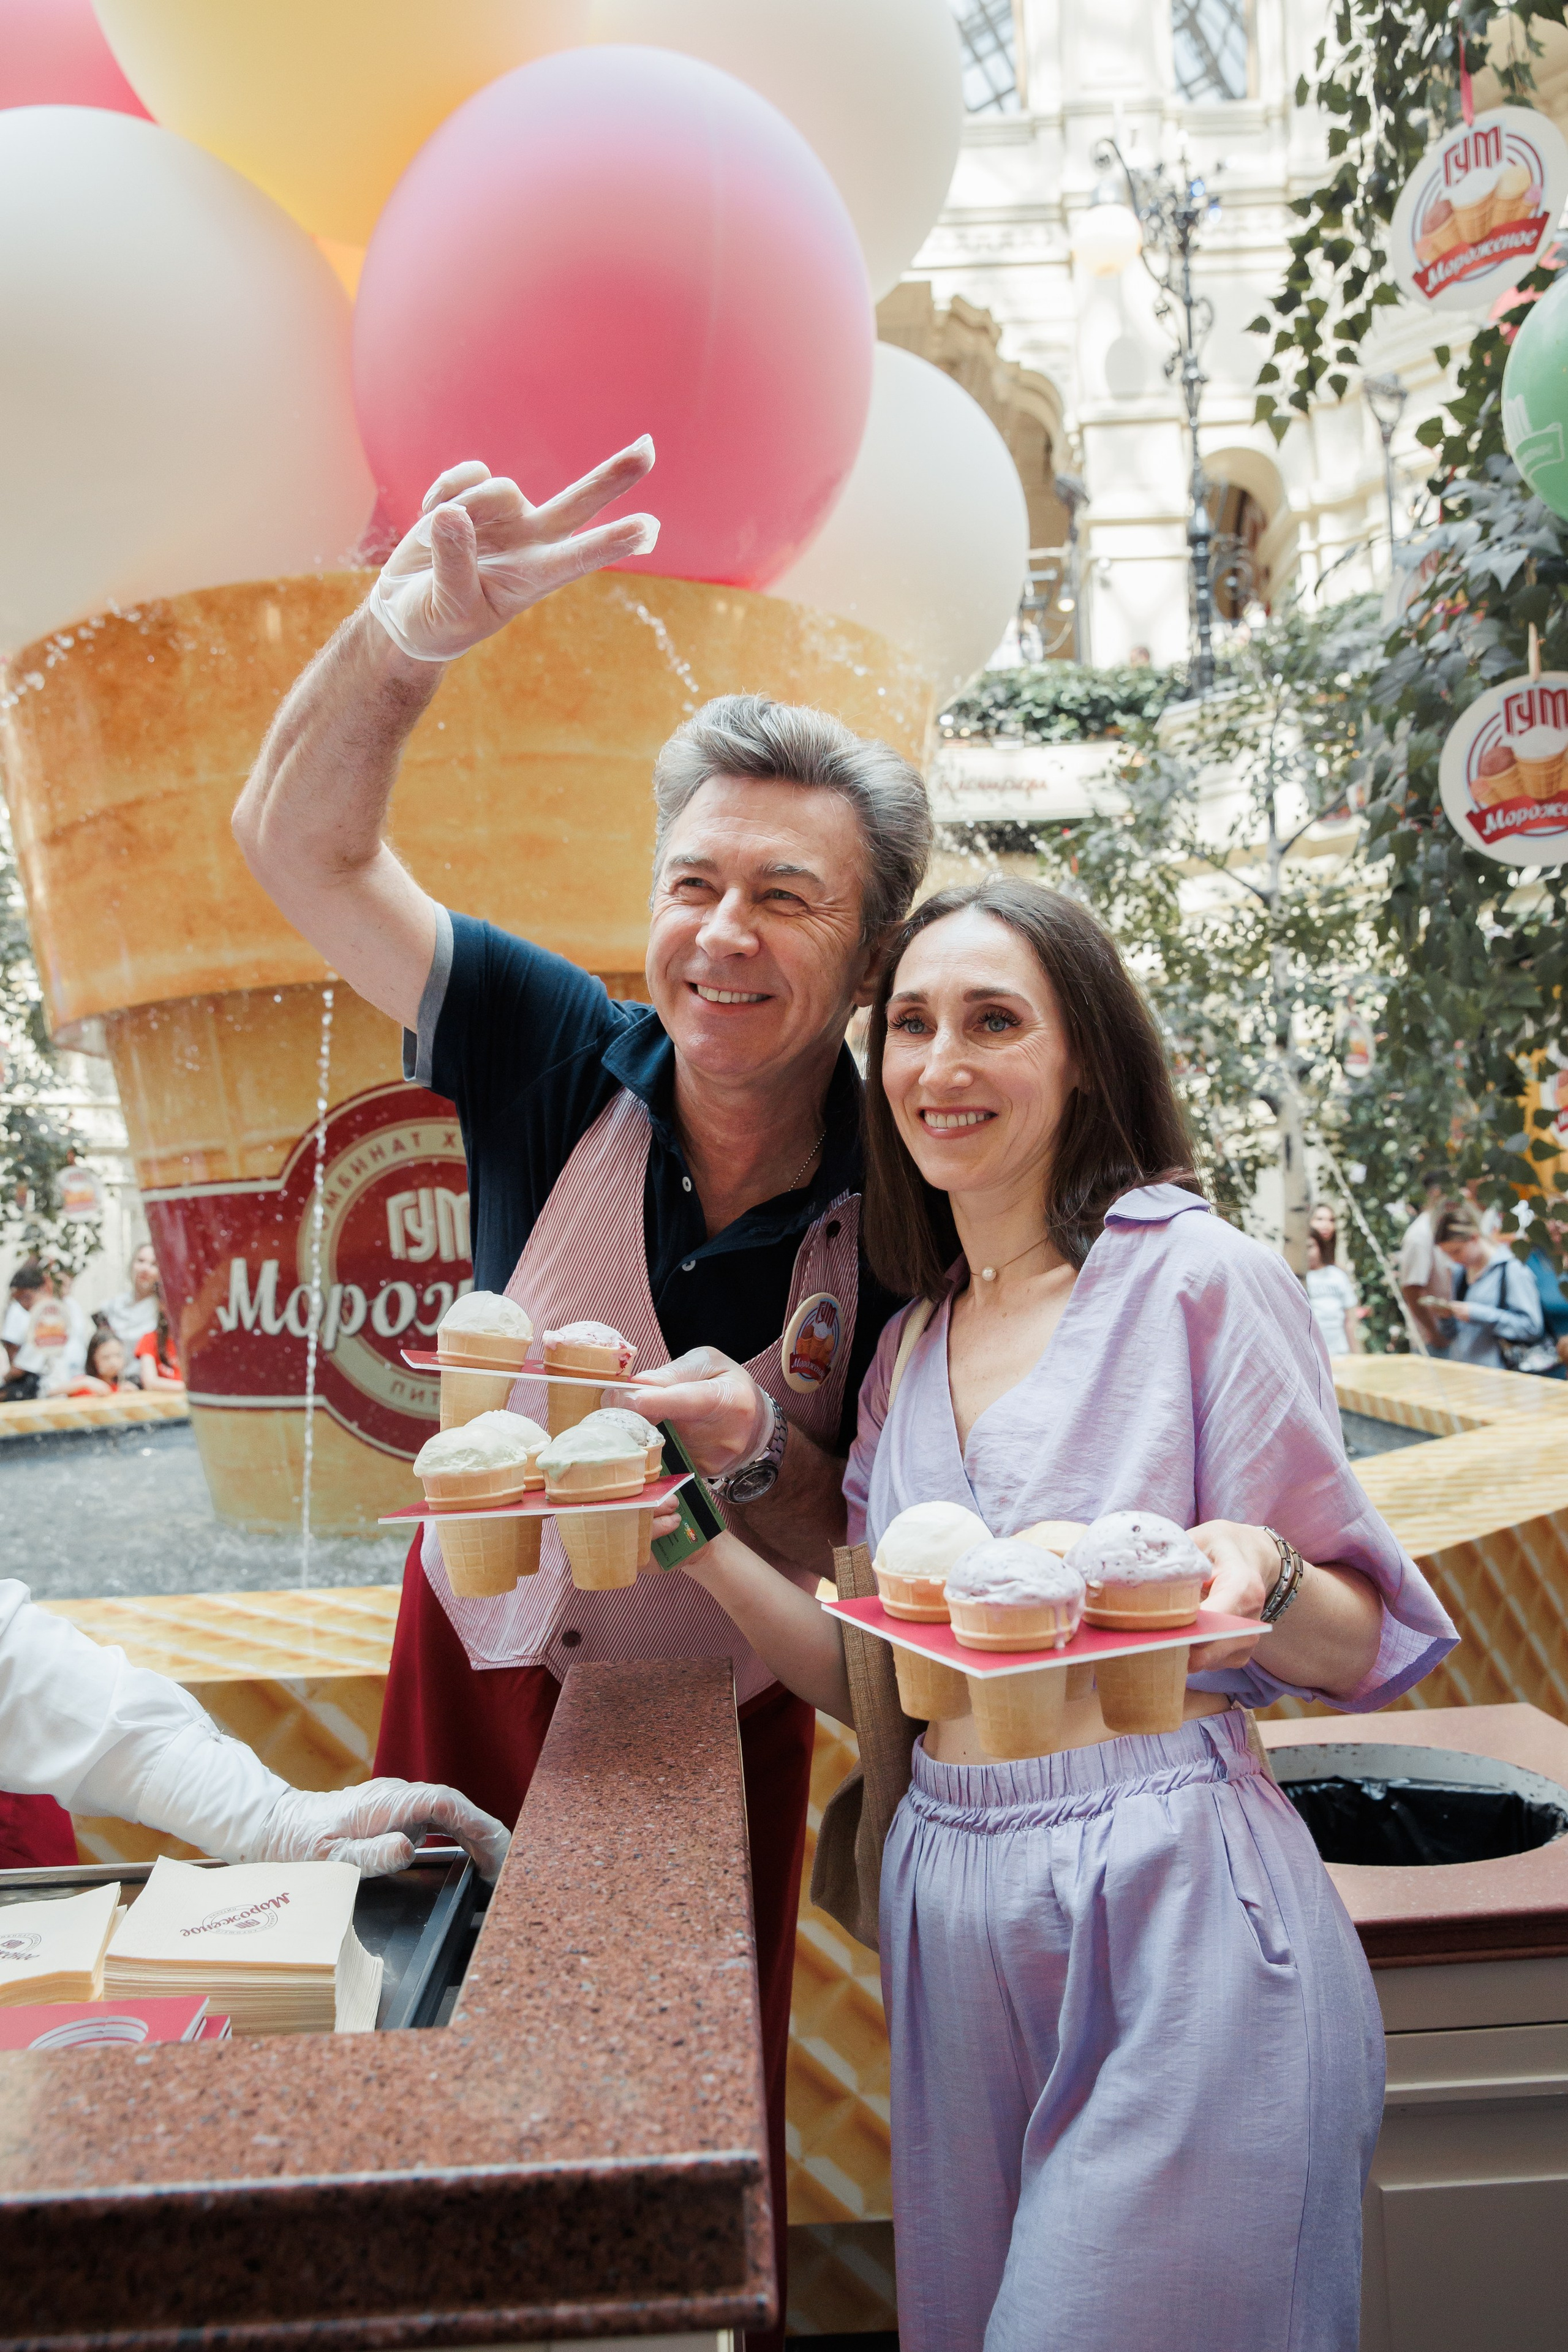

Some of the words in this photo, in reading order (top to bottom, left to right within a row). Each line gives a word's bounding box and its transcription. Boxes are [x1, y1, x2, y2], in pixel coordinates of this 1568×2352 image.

[1444, 126, 1502, 187] ГУМ
[1425, 229, 1538, 292] Мороженое
[791, 1357, 826, 1378] Мороженое
[179, 1892, 290, 1937] Мороженое
[233, 1918, 262, 1929] ГУМ
